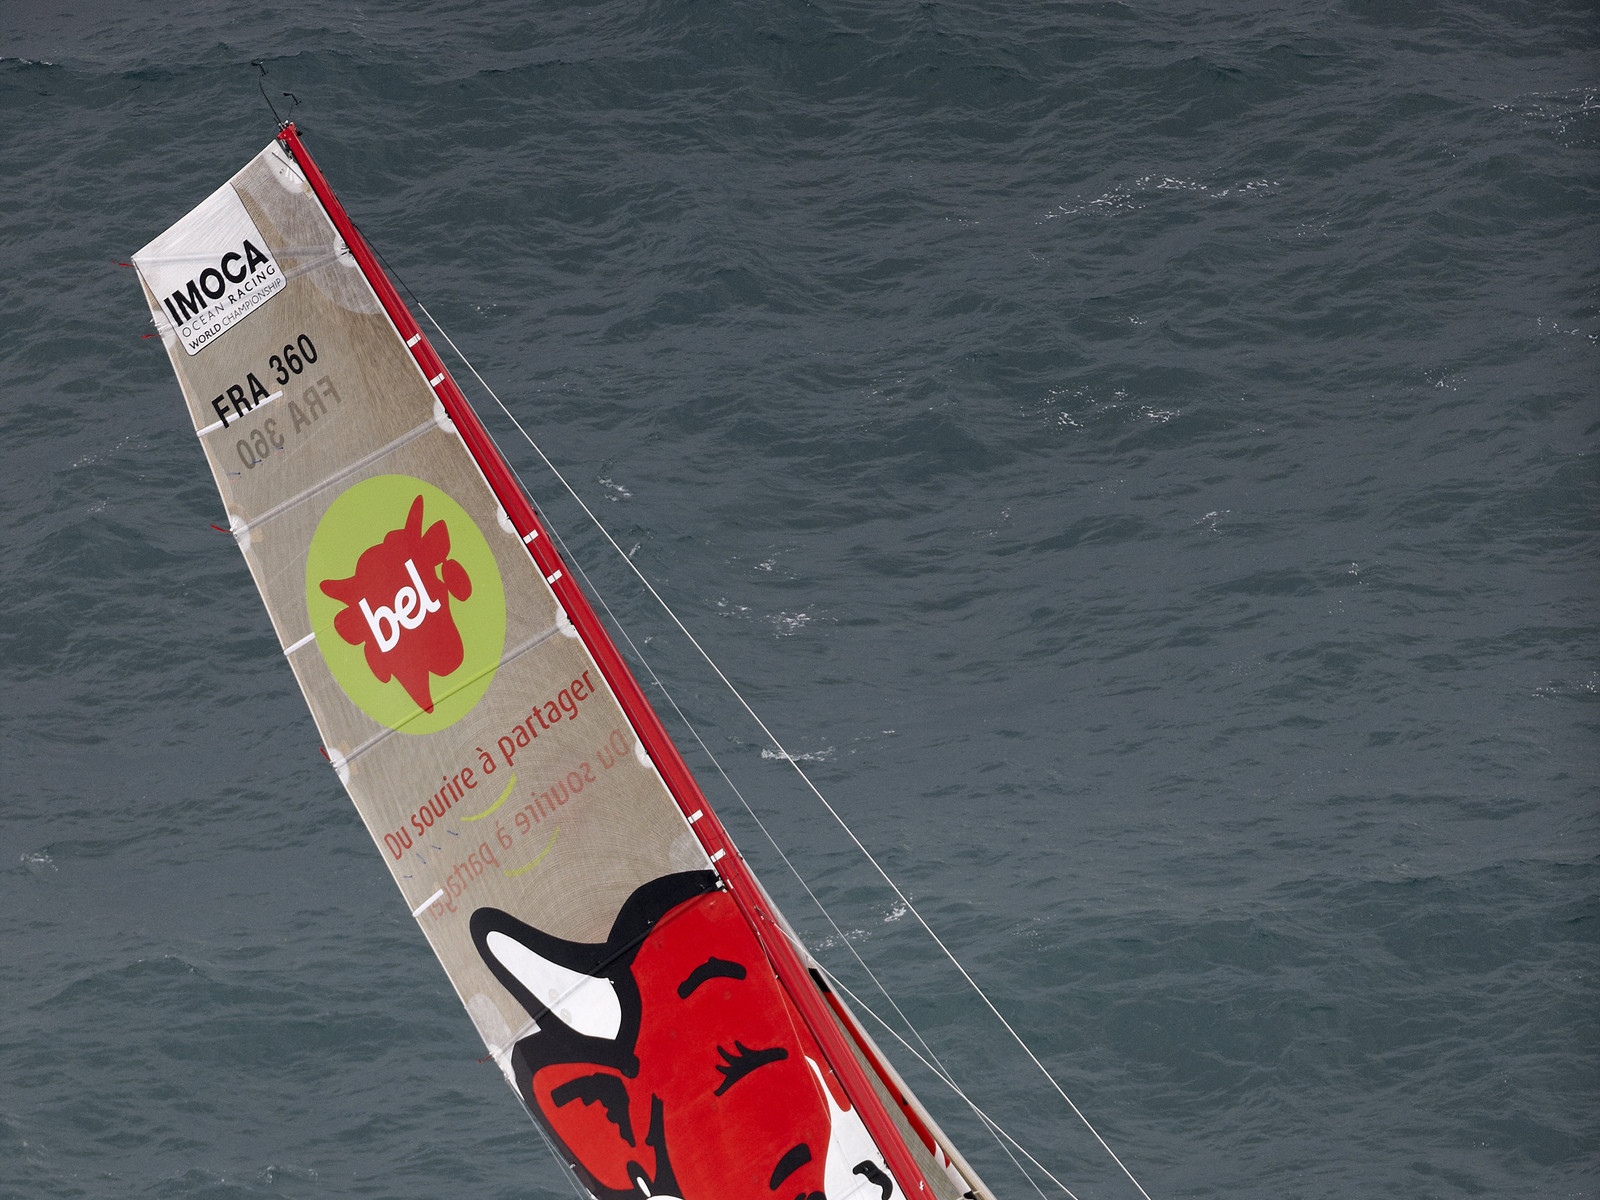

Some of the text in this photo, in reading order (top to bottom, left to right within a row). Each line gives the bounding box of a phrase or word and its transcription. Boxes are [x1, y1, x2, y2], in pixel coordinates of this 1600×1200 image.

[164, 239, 269, 327] IMOCA
[182, 265, 275, 337] OCEAN RACING
[189, 278, 281, 349] WORLD CHAMPIONSHIP
[211, 334, 317, 428] FRA 360
[359, 558, 441, 653] bel
[383, 670, 595, 860] Du sourire à partager
